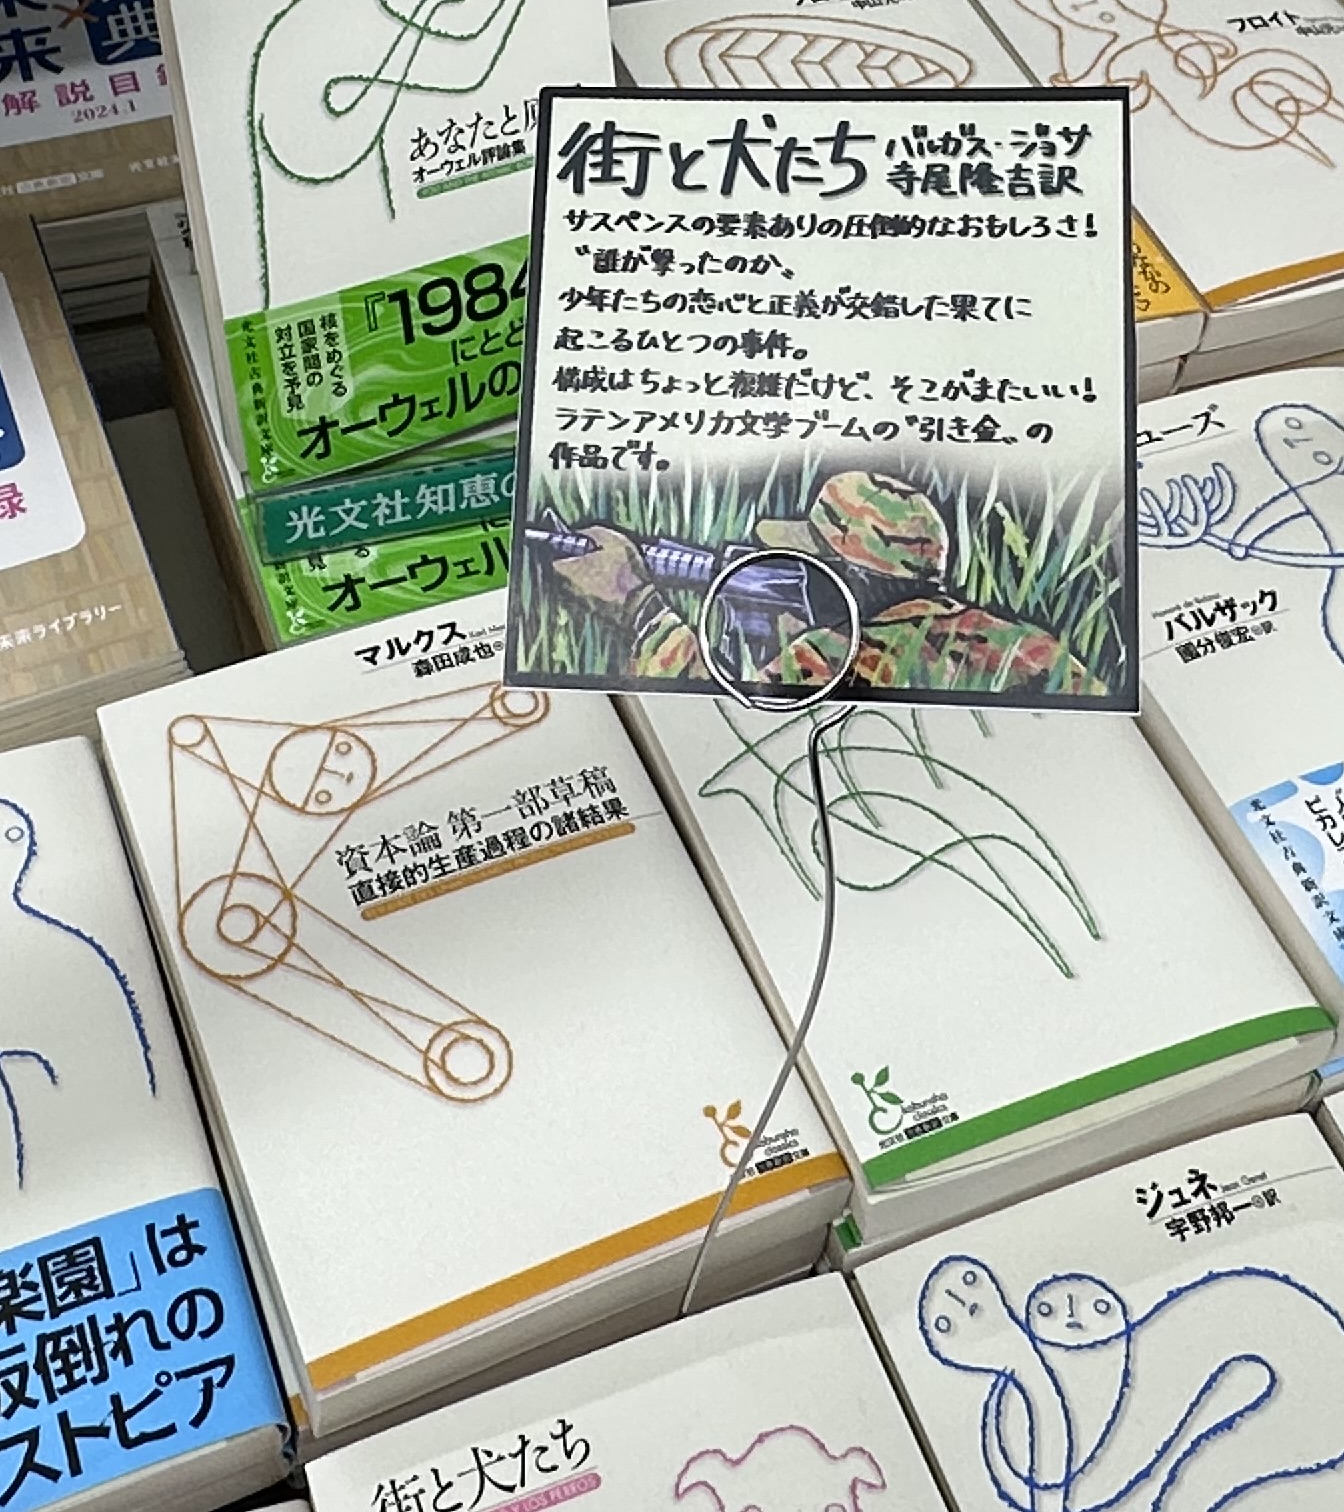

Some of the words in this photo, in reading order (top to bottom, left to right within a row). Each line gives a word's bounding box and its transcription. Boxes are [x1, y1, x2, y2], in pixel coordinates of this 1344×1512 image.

[1226, 9, 1300, 34] フロイト
[554, 112, 879, 201] 街と犬たち
[885, 122, 1094, 160] バルガス・ジョサ
[886, 161, 1084, 198] 寺尾隆吉訳
[554, 328, 810, 362] 起こるひとつの事件。
[297, 360, 523, 460] オーウェルの
[549, 439, 671, 473] 作品です。
[1163, 589, 1280, 643] バルザック
[354, 620, 468, 666] マルクス
[334, 821, 444, 883] 資本論
[447, 764, 619, 842] 第一部草稿
[348, 799, 631, 907] 直接的生産過程の諸結果
[1135, 1167, 1219, 1219] ジュネ
[370, 1418, 591, 1512] 街と犬たち
